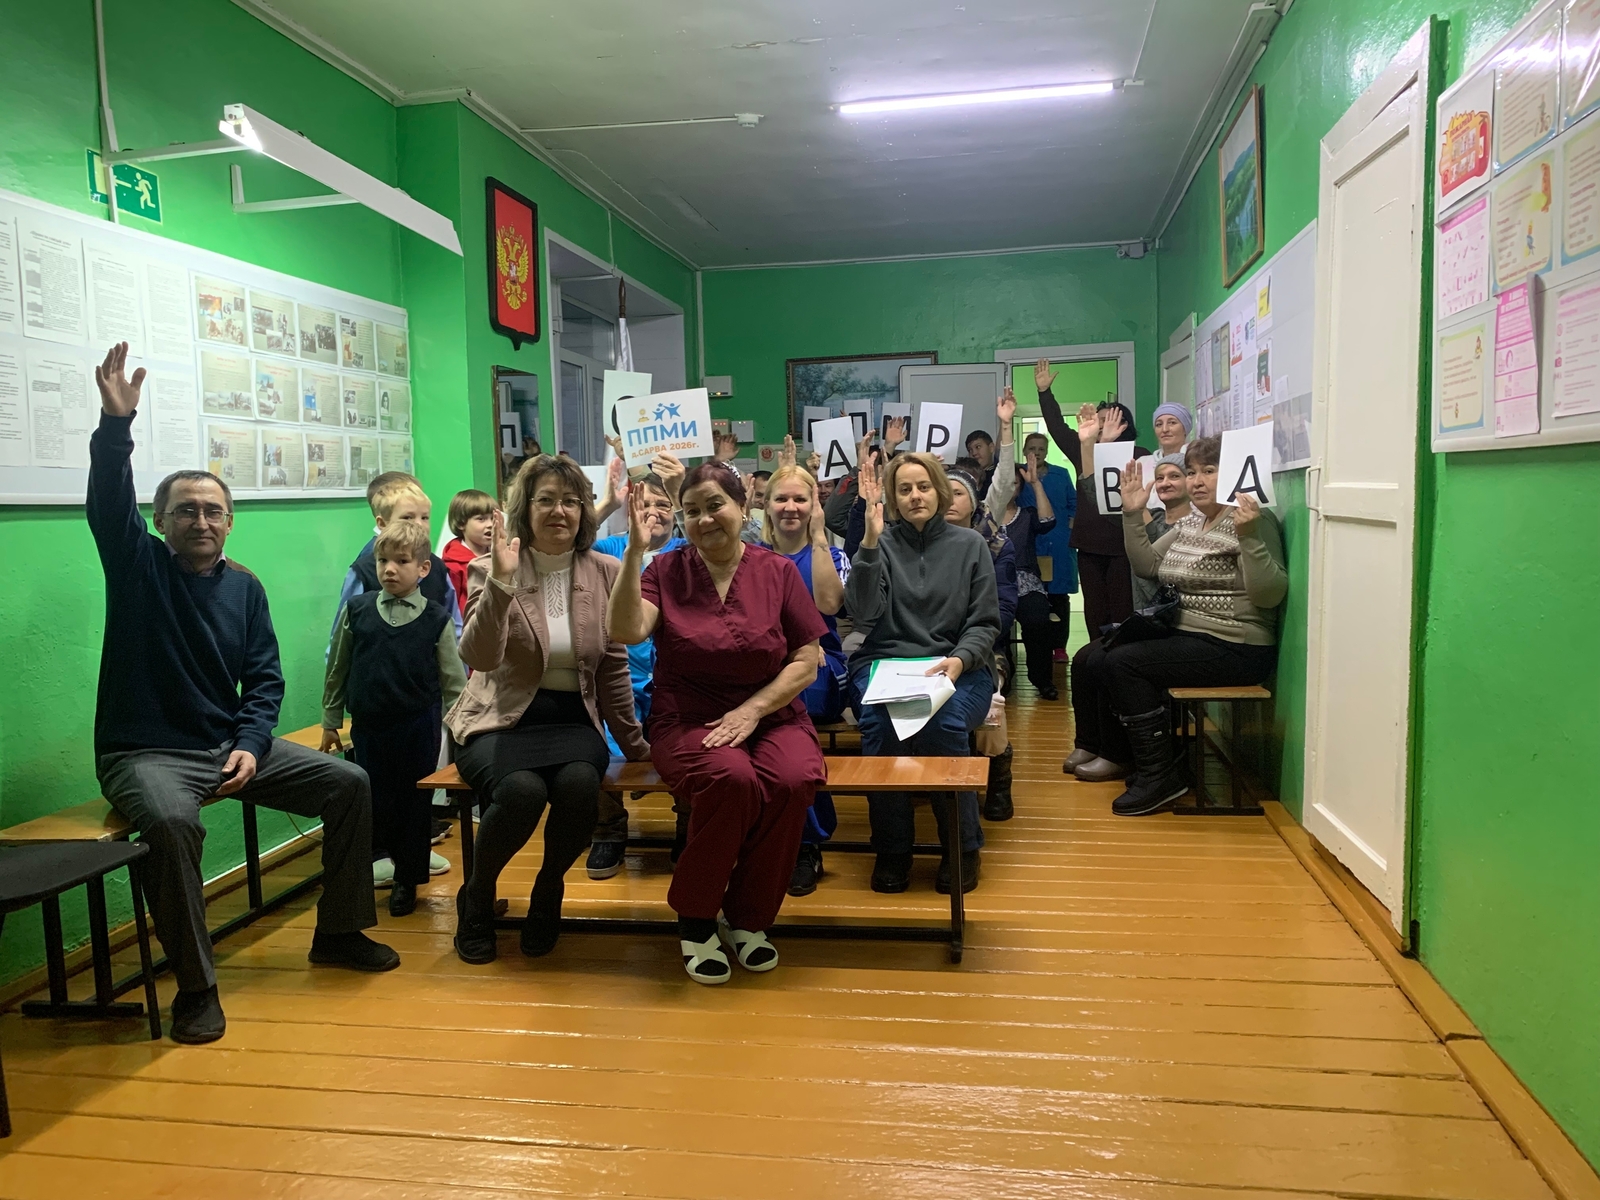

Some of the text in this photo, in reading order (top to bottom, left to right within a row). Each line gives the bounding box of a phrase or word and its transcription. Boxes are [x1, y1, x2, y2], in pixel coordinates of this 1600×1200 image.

[627, 420, 698, 447] ППМИ
[631, 441, 700, 459] д.САРВА 2026г.
[926, 423, 950, 453] Р
[824, 439, 853, 478] А
[1102, 467, 1123, 512] В
[1226, 454, 1270, 504] А
